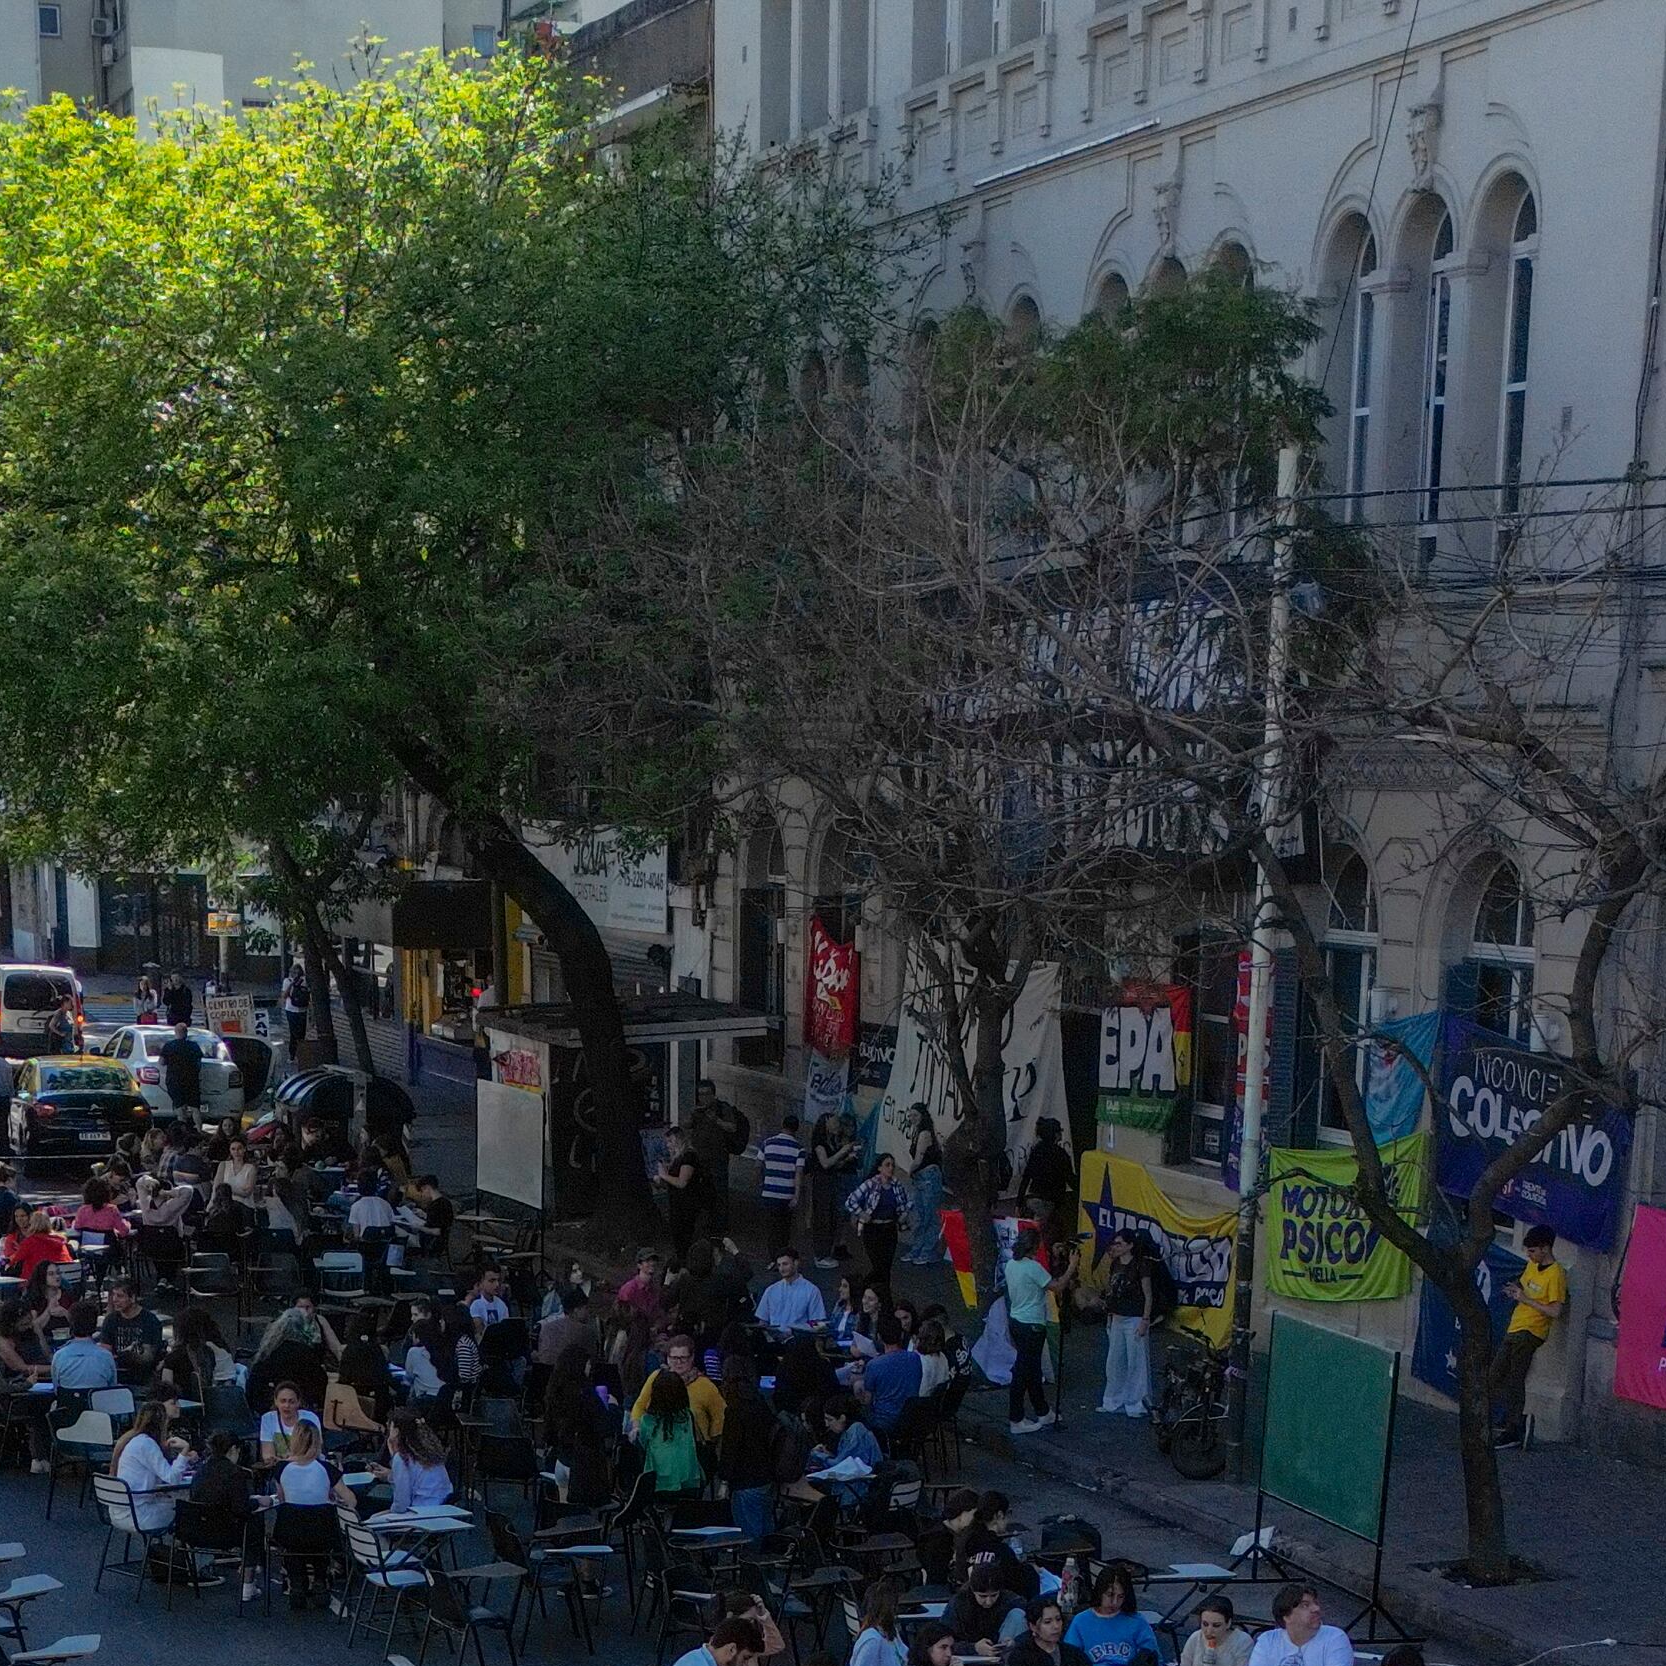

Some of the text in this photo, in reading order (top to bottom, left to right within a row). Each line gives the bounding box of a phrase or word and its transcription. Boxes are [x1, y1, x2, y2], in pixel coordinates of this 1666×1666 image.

[255, 1012, 268, 1037] PAN
[1099, 1006, 1177, 1092] EPA
[1474, 1051, 1594, 1120] INCONCIEE
[1098, 1207, 1115, 1229] EL
[1280, 1219, 1366, 1264] PSICO
